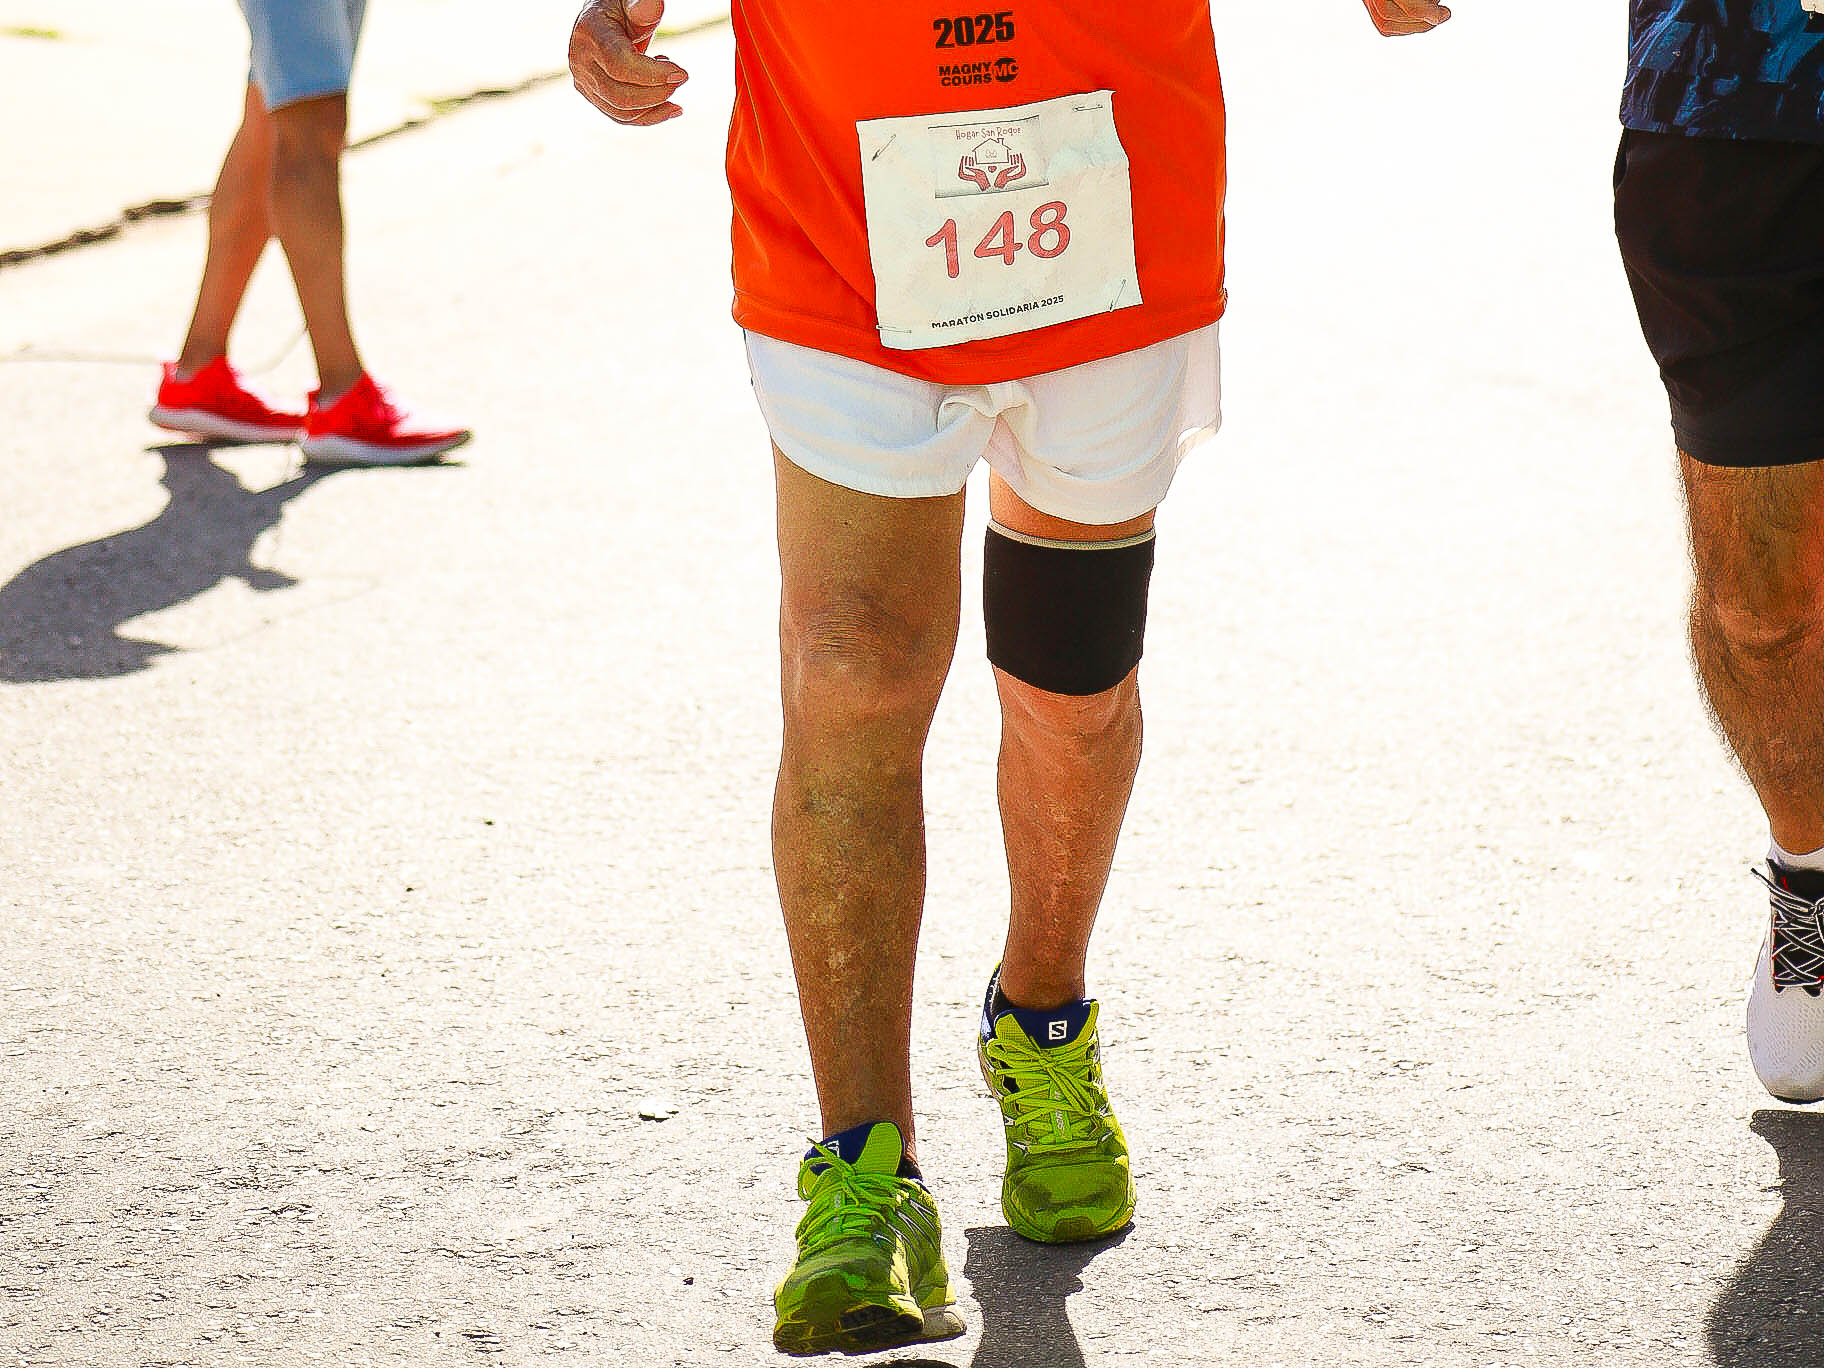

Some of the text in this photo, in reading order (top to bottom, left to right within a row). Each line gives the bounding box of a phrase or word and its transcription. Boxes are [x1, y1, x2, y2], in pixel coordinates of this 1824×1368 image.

[933, 11, 1015, 49] 2025
[938, 61, 993, 76] MAGNY
[941, 73, 993, 86] COURS
[981, 127, 996, 139] San
[925, 201, 1071, 279] 148
[931, 294, 1065, 329] MARATON SOLIDARIA 2025
